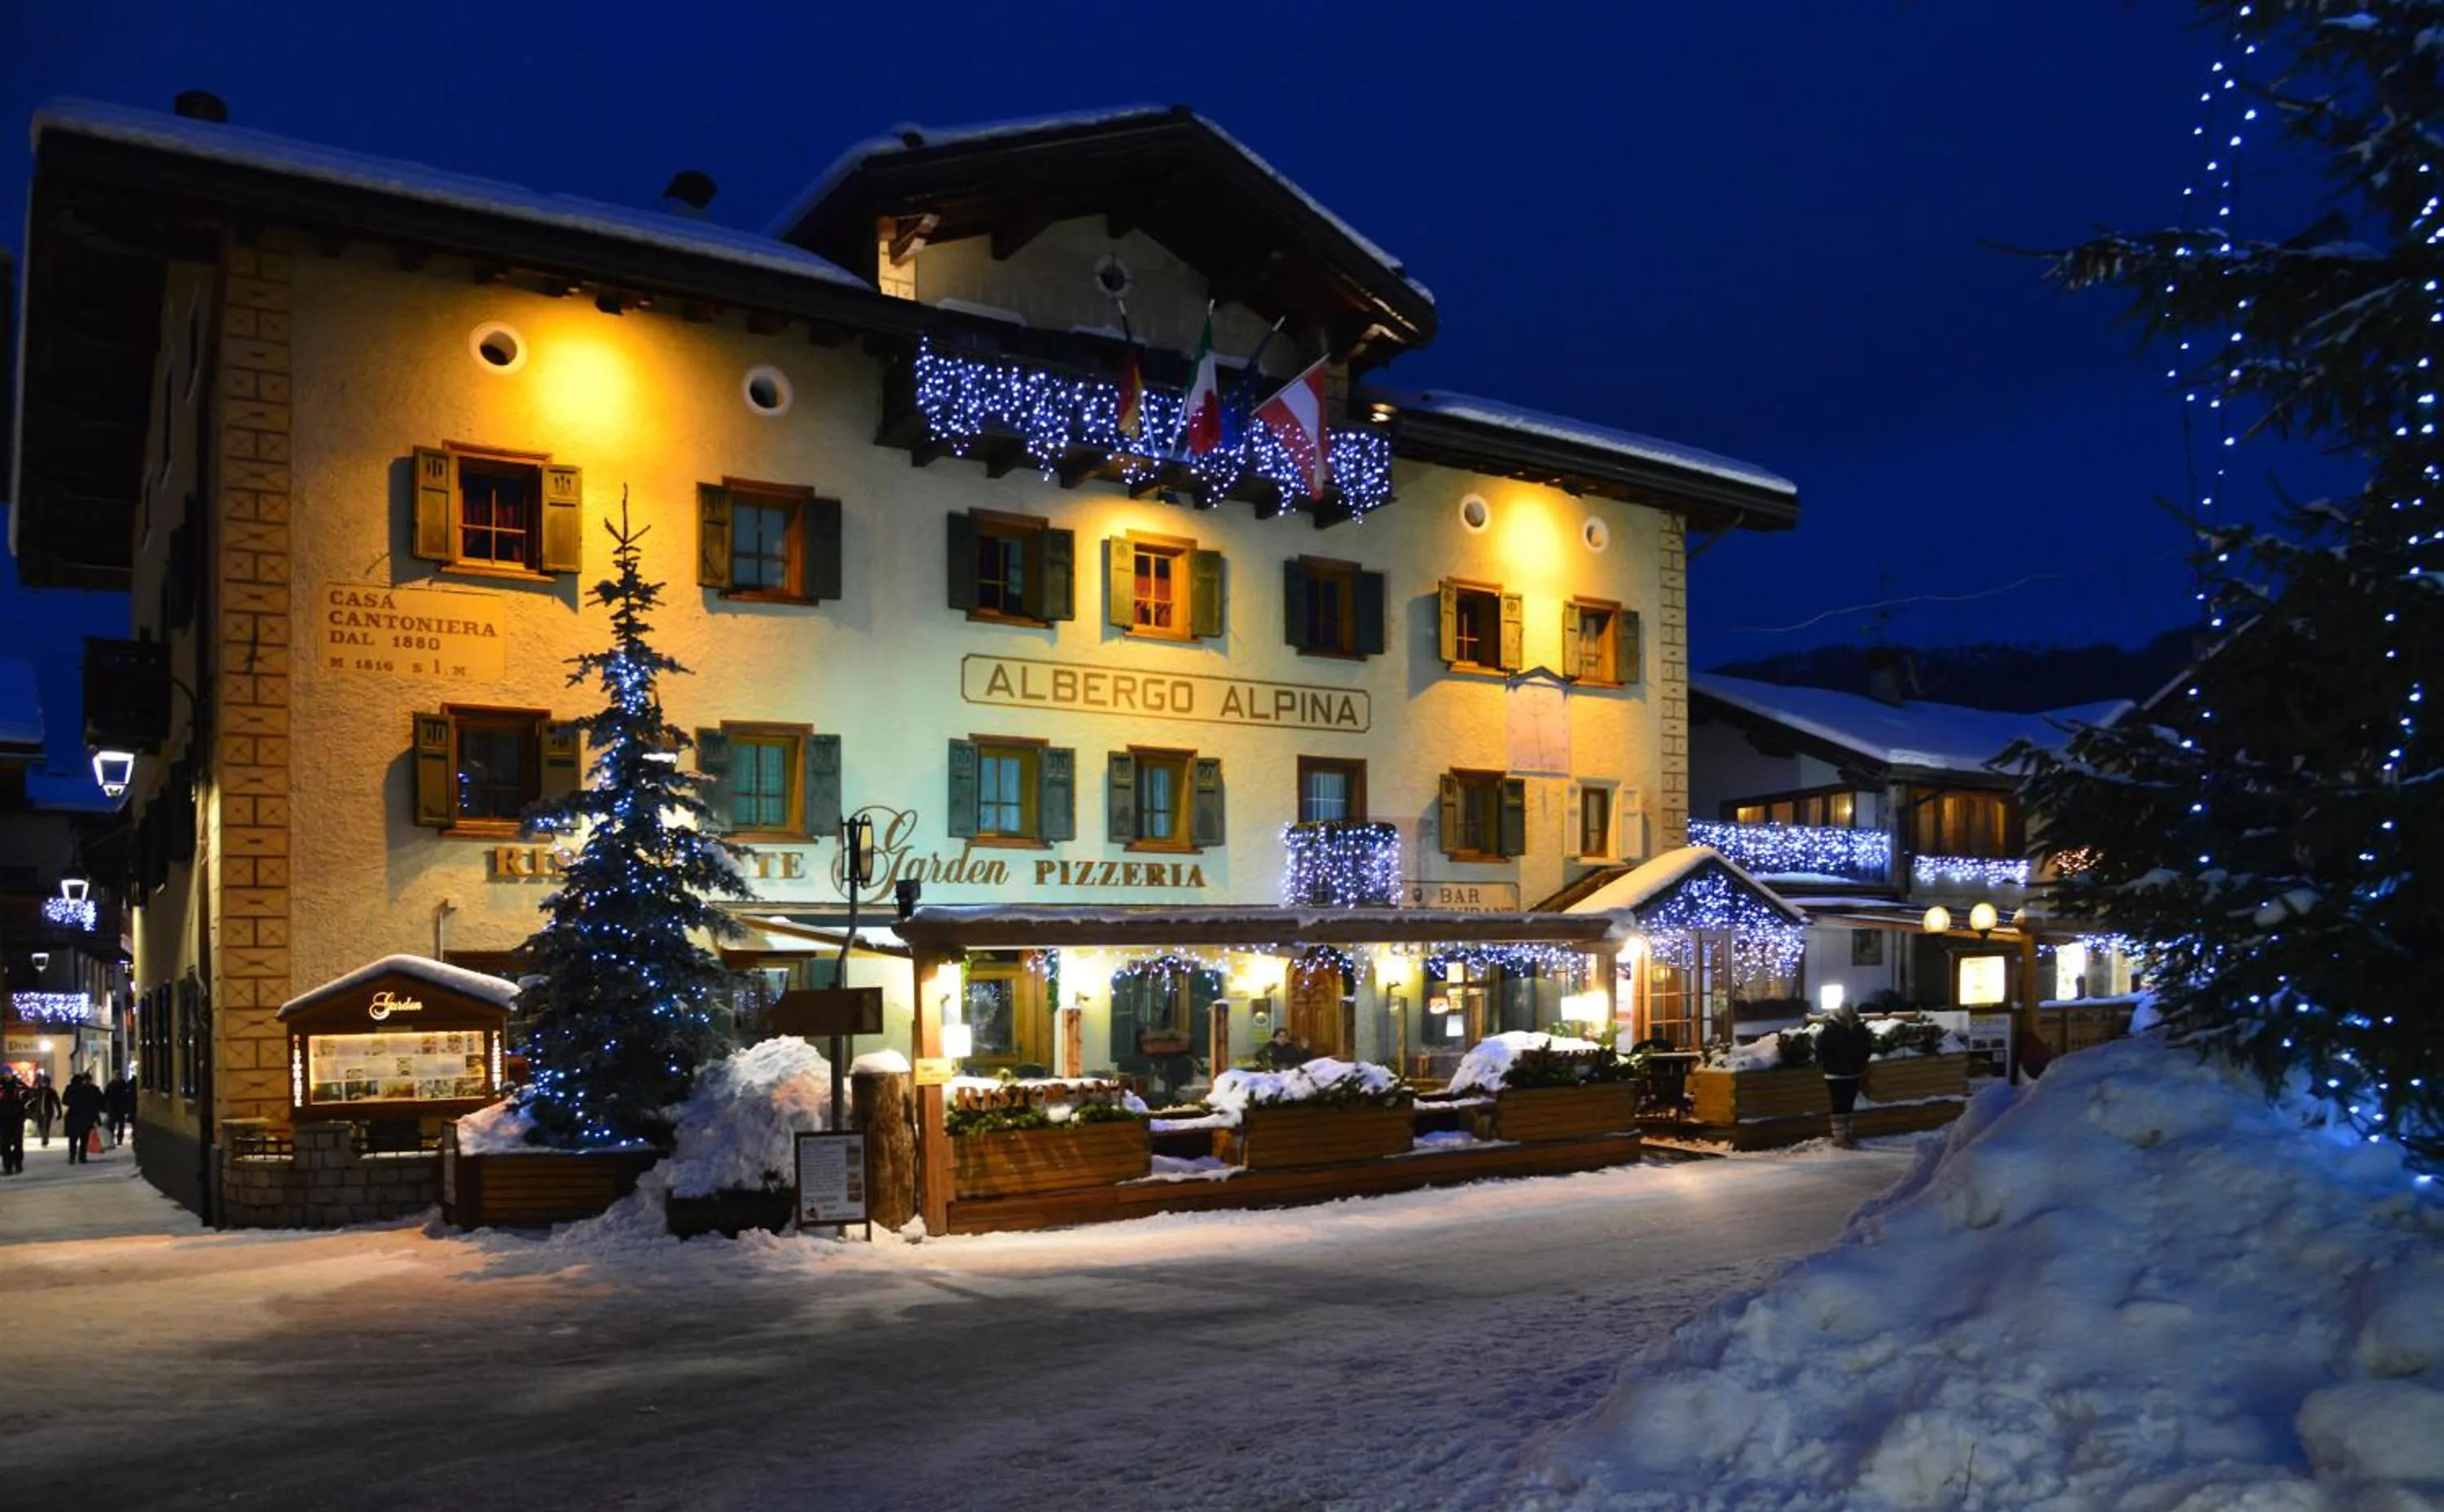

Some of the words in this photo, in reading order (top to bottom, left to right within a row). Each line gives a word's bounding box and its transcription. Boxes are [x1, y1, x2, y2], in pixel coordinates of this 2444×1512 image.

[329, 589, 397, 610] CASA
[329, 610, 498, 638] CANTONIERA
[329, 630, 376, 646] DAL
[392, 635, 442, 651] 1880
[985, 664, 1194, 714] ALBERGO
[1220, 684, 1359, 725] ALPINA
[494, 843, 806, 878] RISTE
[831, 805, 1009, 904] Garden
[1033, 859, 1207, 888] PIZZERIA
[1440, 887, 1480, 904] BAR
[369, 991, 423, 1021] Garden
